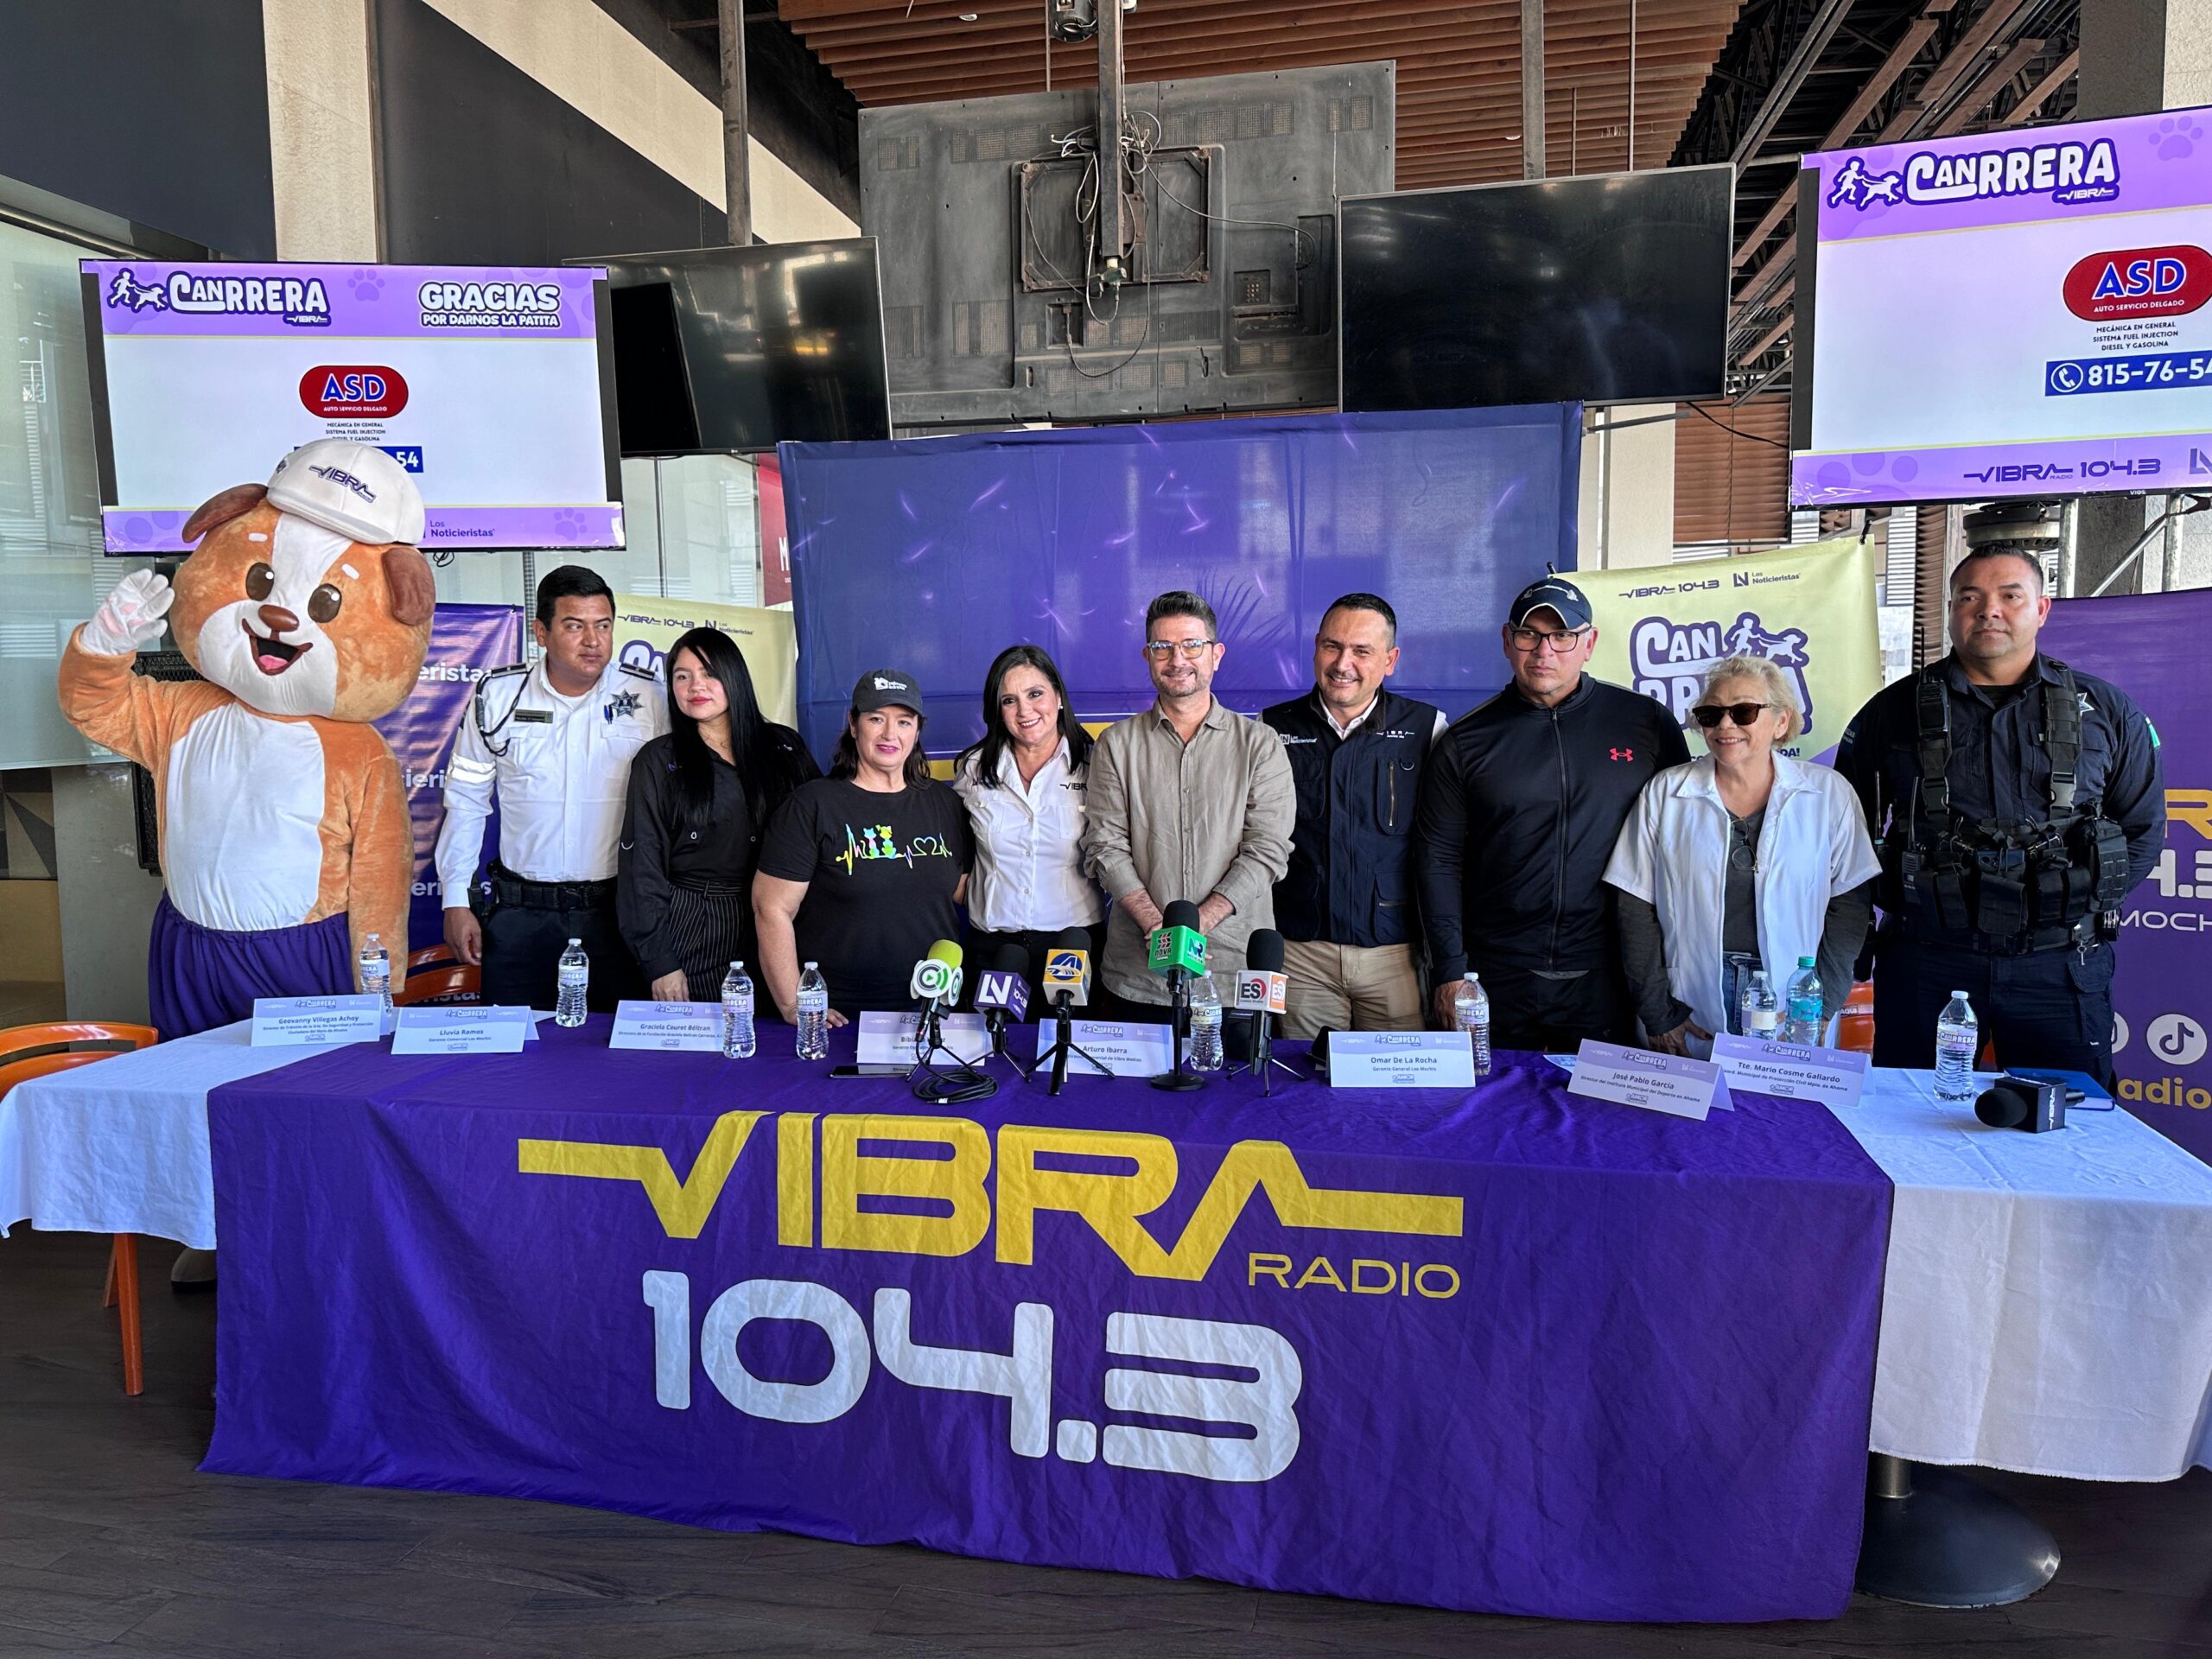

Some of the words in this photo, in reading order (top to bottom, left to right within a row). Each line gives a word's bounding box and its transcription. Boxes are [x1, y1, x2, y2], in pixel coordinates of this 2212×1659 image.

[2057, 188, 2113, 200] VIBRA
[2091, 257, 2187, 300] ASD
[419, 282, 560, 312] GRACIAS
[2115, 302, 2148, 311] SERVICIO
[2150, 299, 2185, 308] DELGADO
[423, 314, 447, 325] POR
[449, 314, 499, 326] DARNOS
[501, 315, 517, 326] LA
[518, 315, 558, 326] PATITA
[2096, 324, 2132, 333] MECÁNICA
[2141, 330, 2178, 340] INJECTION
[2133, 340, 2169, 349] GASOLINA
[321, 373, 386, 402] ASD
[396, 451, 419, 467] 54
[1963, 463, 2073, 483] VIBRA
[2080, 458, 2161, 478] 104.3
[308, 465, 376, 504] VIBRA
[430, 528, 496, 537] Noticieristas
[1752, 573, 1802, 585] Noticieristas
[1618, 585, 1676, 600] VIBRA
[1678, 579, 1719, 593] 104.3
[617, 614, 662, 625] VIBRA
[1059, 782, 1089, 791] VIBR
[1241, 982, 1261, 999] ES
[1612, 1071, 1629, 1081] José
[1629, 1075, 1649, 1085] Pablo
[1651, 1078, 1675, 1090] García
[1738, 1061, 1752, 1070] Tte.
[1754, 1064, 1777, 1074] Mario
[1778, 1068, 1805, 1077] Cosme
[1806, 1071, 1840, 1083] Gallardo
[2117, 1077, 2212, 1109] adio
[518, 1110, 1465, 1282] VIBRA
[1248, 1251, 1460, 1300] RADIO
[641, 1269, 1303, 1482] 104.3
